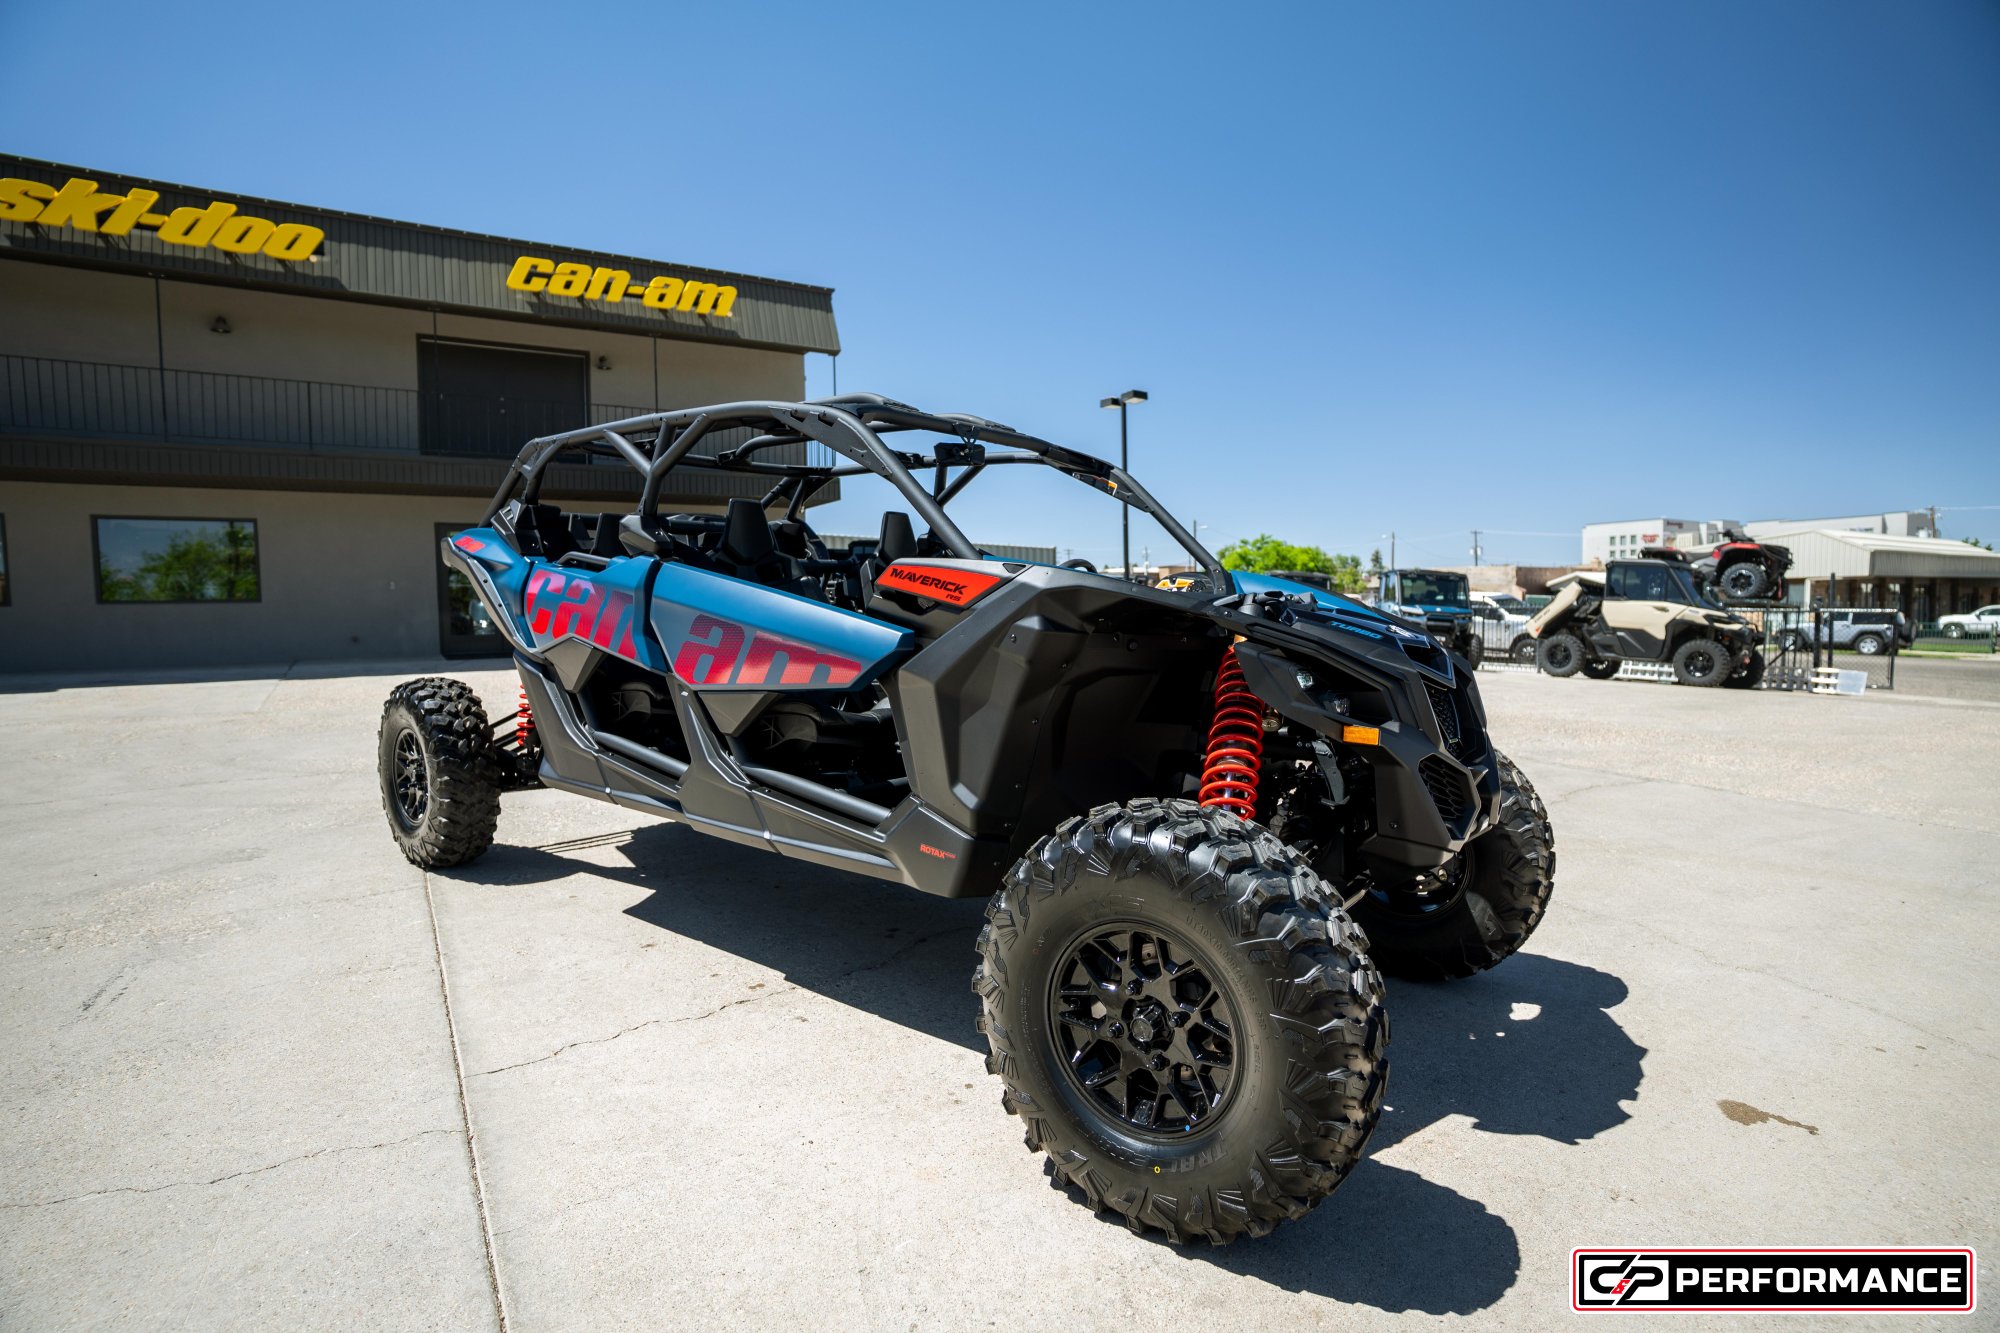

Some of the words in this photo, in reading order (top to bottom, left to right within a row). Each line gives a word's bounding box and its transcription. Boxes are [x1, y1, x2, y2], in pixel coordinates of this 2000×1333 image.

[0, 177, 325, 262] ski-doo
[506, 255, 738, 317] can-am
[889, 567, 968, 595] MAVERICK
[946, 593, 962, 601] RS
[1329, 620, 1384, 640] TURBO
[919, 843, 945, 859] ROTAX
